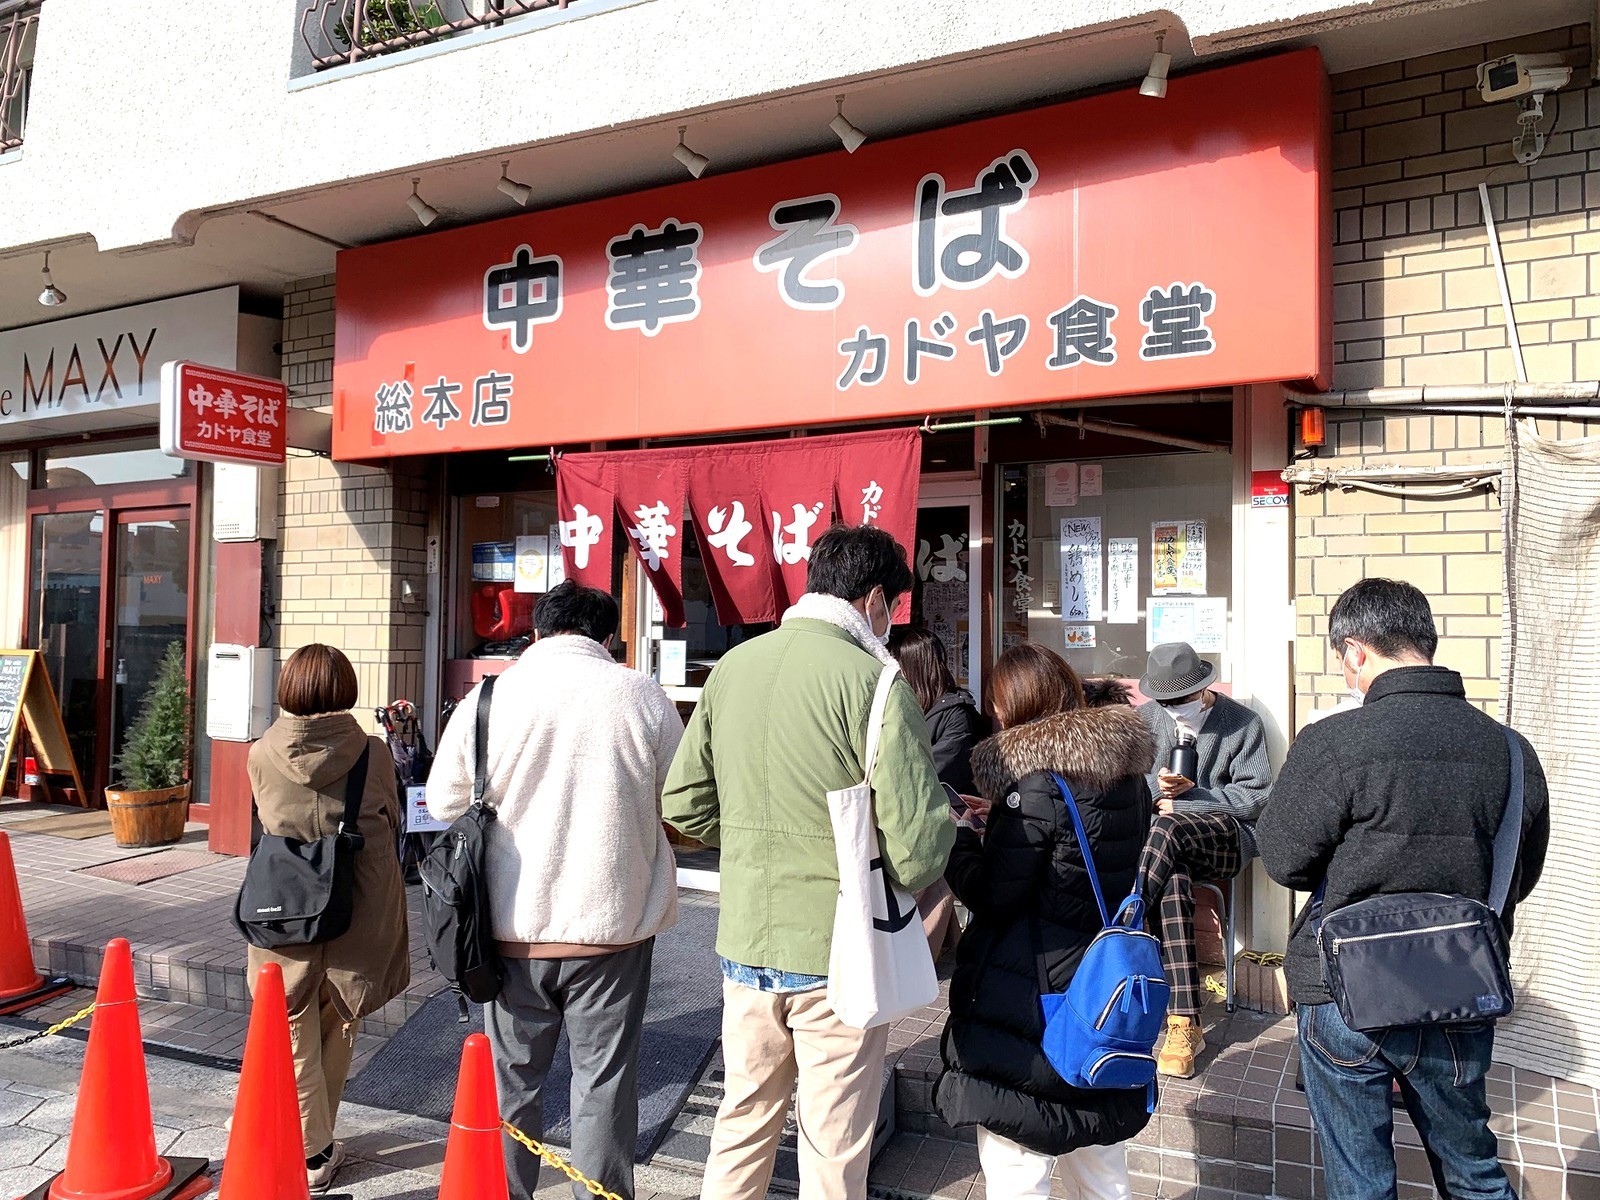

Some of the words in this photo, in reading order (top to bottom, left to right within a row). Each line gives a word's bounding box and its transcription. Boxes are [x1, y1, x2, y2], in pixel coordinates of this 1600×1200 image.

[483, 150, 1038, 354] 中華そば
[838, 282, 1216, 391] カドヤ食堂
[22, 327, 157, 413] MAXY
[188, 383, 281, 428] 中華そば
[375, 371, 514, 434] 総本店
[197, 420, 272, 448] カドヤ食堂
[860, 480, 883, 530] カド
[1067, 523, 1089, 533] NEW
[1253, 496, 1290, 506] SECOM
[559, 500, 824, 572] 中華そば
[1121, 543, 1133, 588] 路上駐車
[1008, 519, 1035, 614] カドヤ食堂
[1068, 543, 1082, 602] 鶏めし
